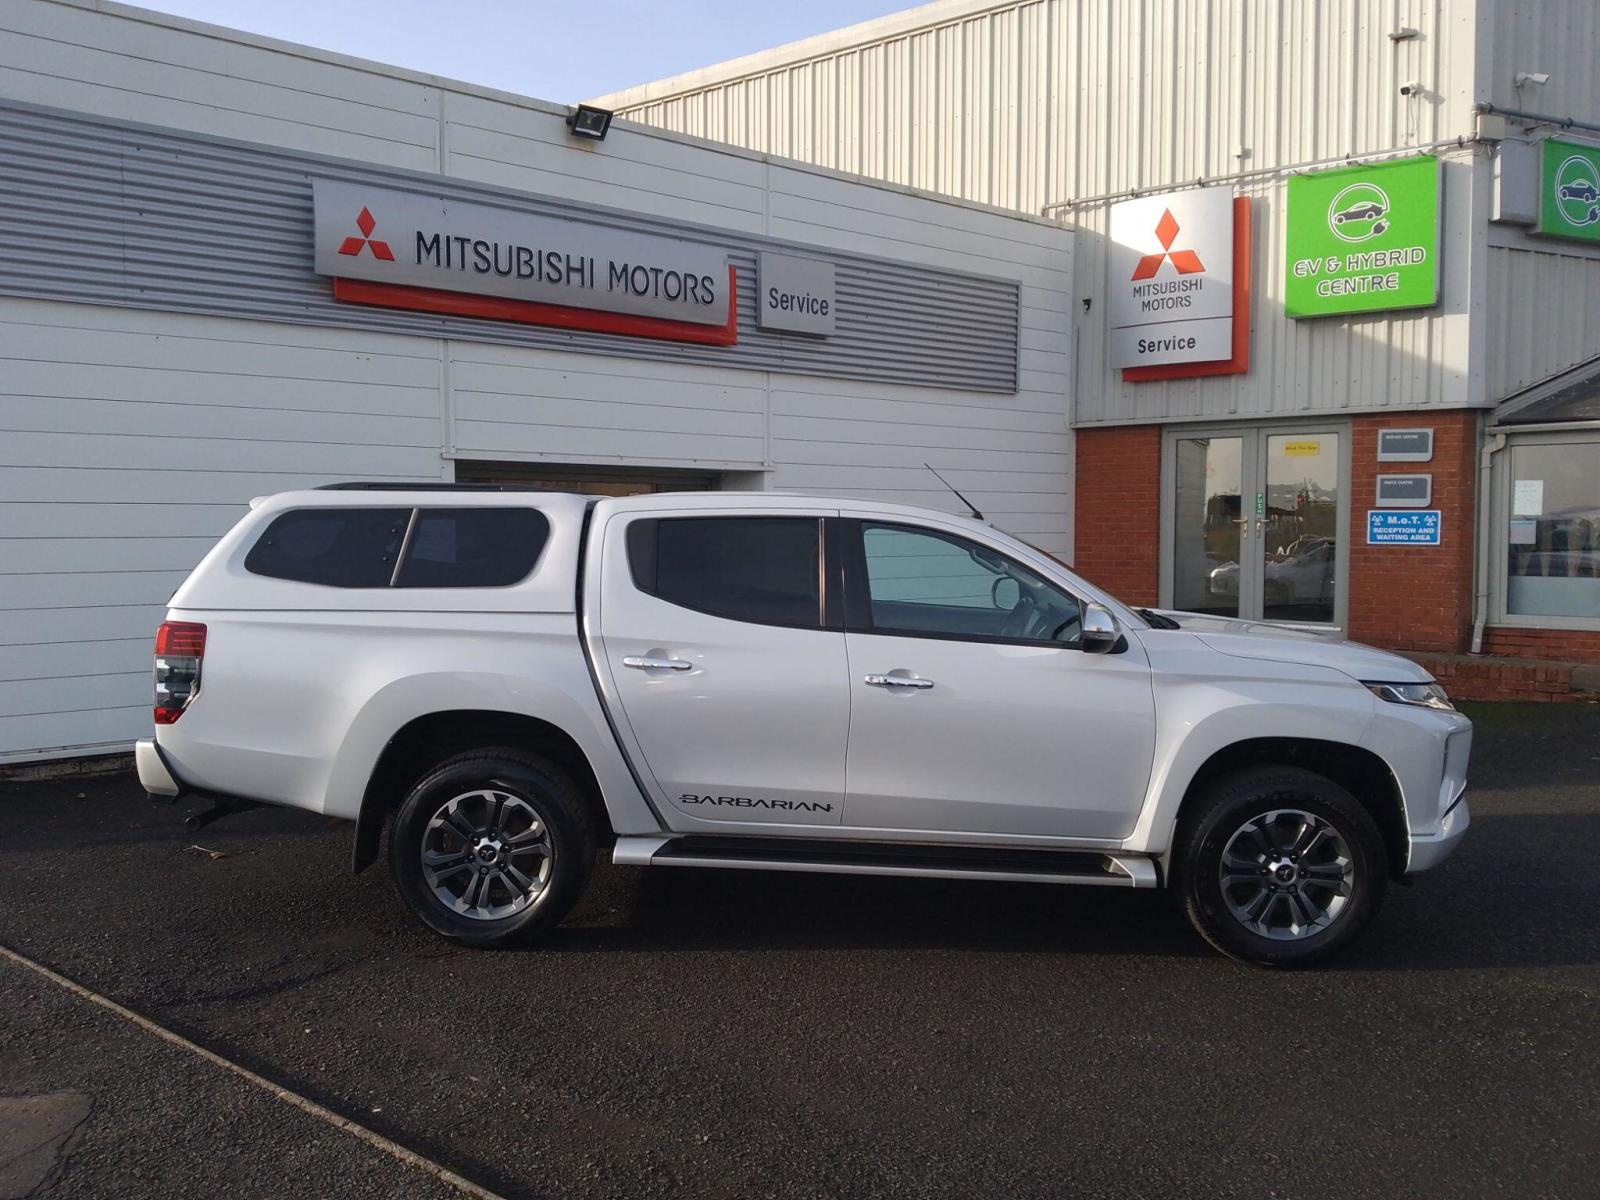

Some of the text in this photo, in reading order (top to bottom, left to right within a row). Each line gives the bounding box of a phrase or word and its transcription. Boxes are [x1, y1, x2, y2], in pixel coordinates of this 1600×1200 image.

[415, 230, 715, 306] MITSUBISHI MOTORS
[1294, 247, 1426, 277] EV & HYBRID
[1133, 278, 1203, 298] MITSUBISHI
[1317, 272, 1399, 296] CENTRE
[768, 287, 829, 316] Service
[1142, 295, 1192, 312] MOTORS
[1138, 335, 1196, 354] Service
[1387, 516, 1420, 524] M.o.T.
[678, 794, 834, 813] BARBARIAN
